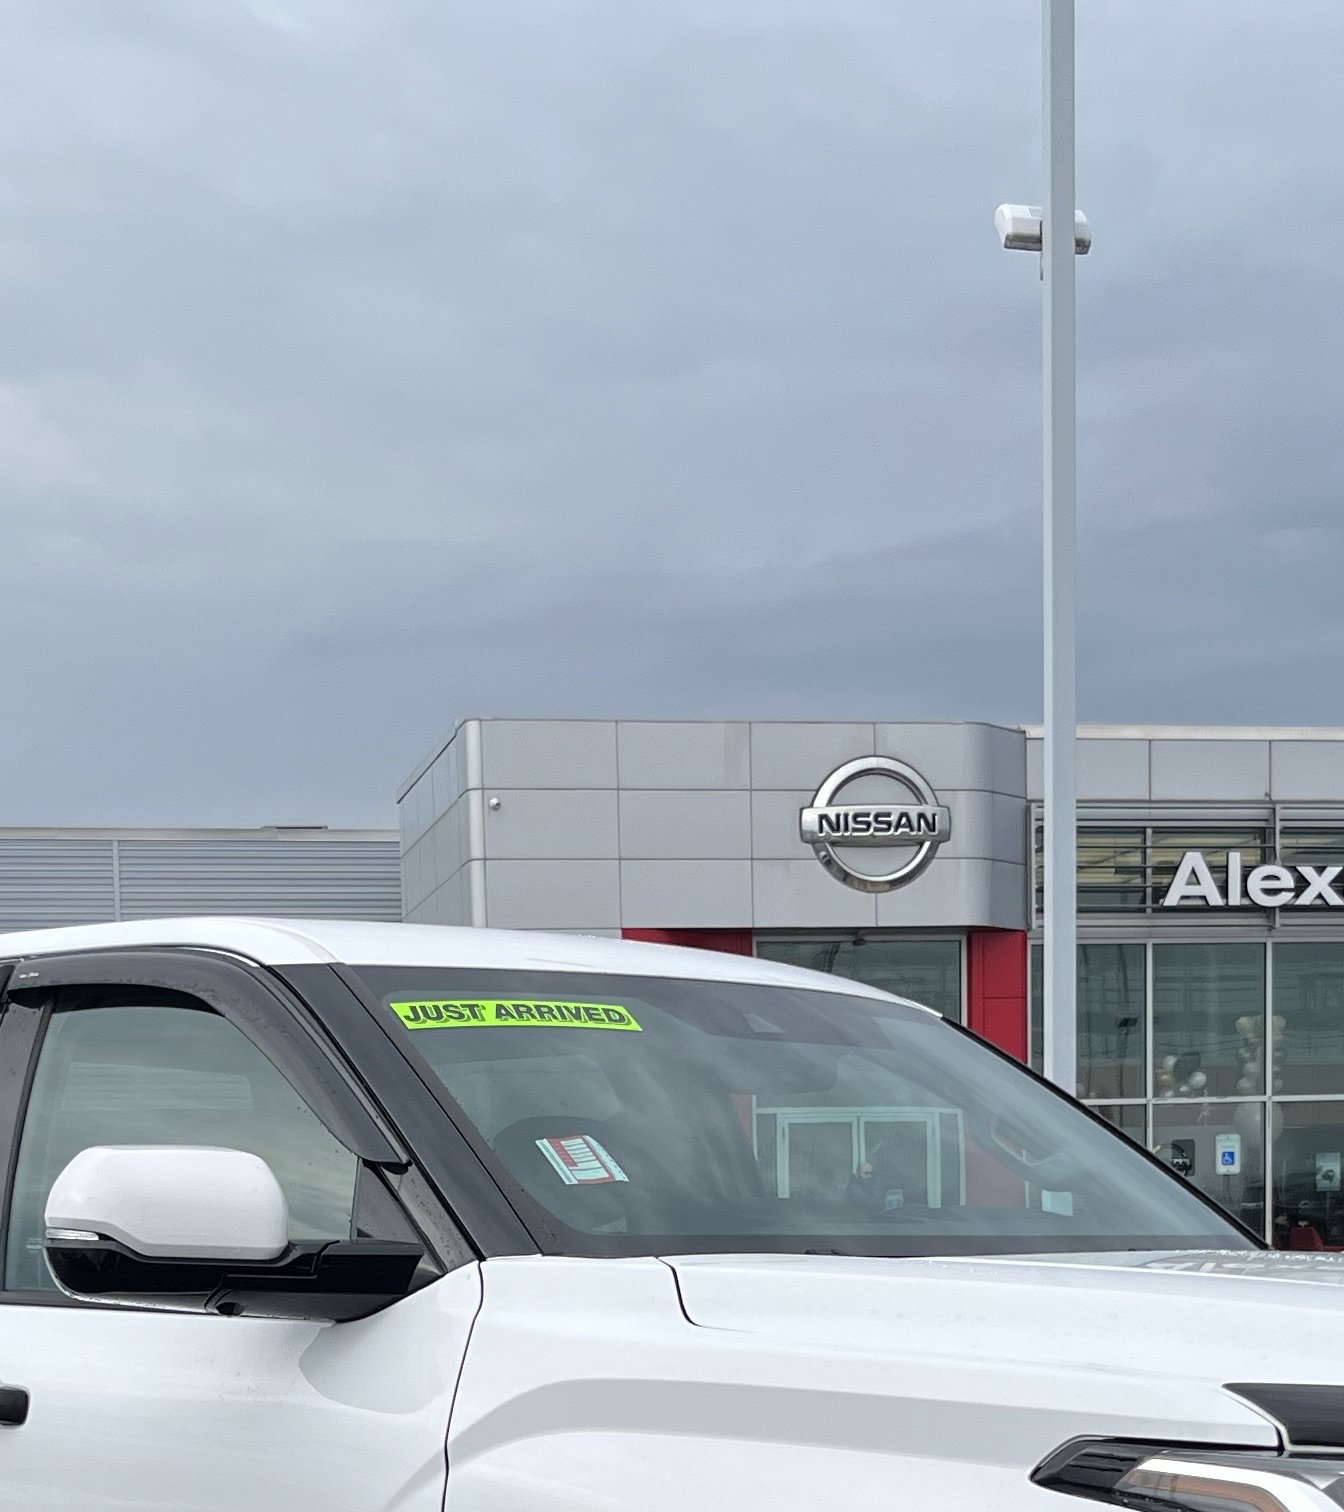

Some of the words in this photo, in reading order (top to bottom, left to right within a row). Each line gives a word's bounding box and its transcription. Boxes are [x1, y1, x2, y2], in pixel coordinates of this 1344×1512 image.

[818, 811, 938, 836] NISSAN
[403, 1003, 486, 1024] JUST
[495, 1003, 633, 1026] ARRIVED
